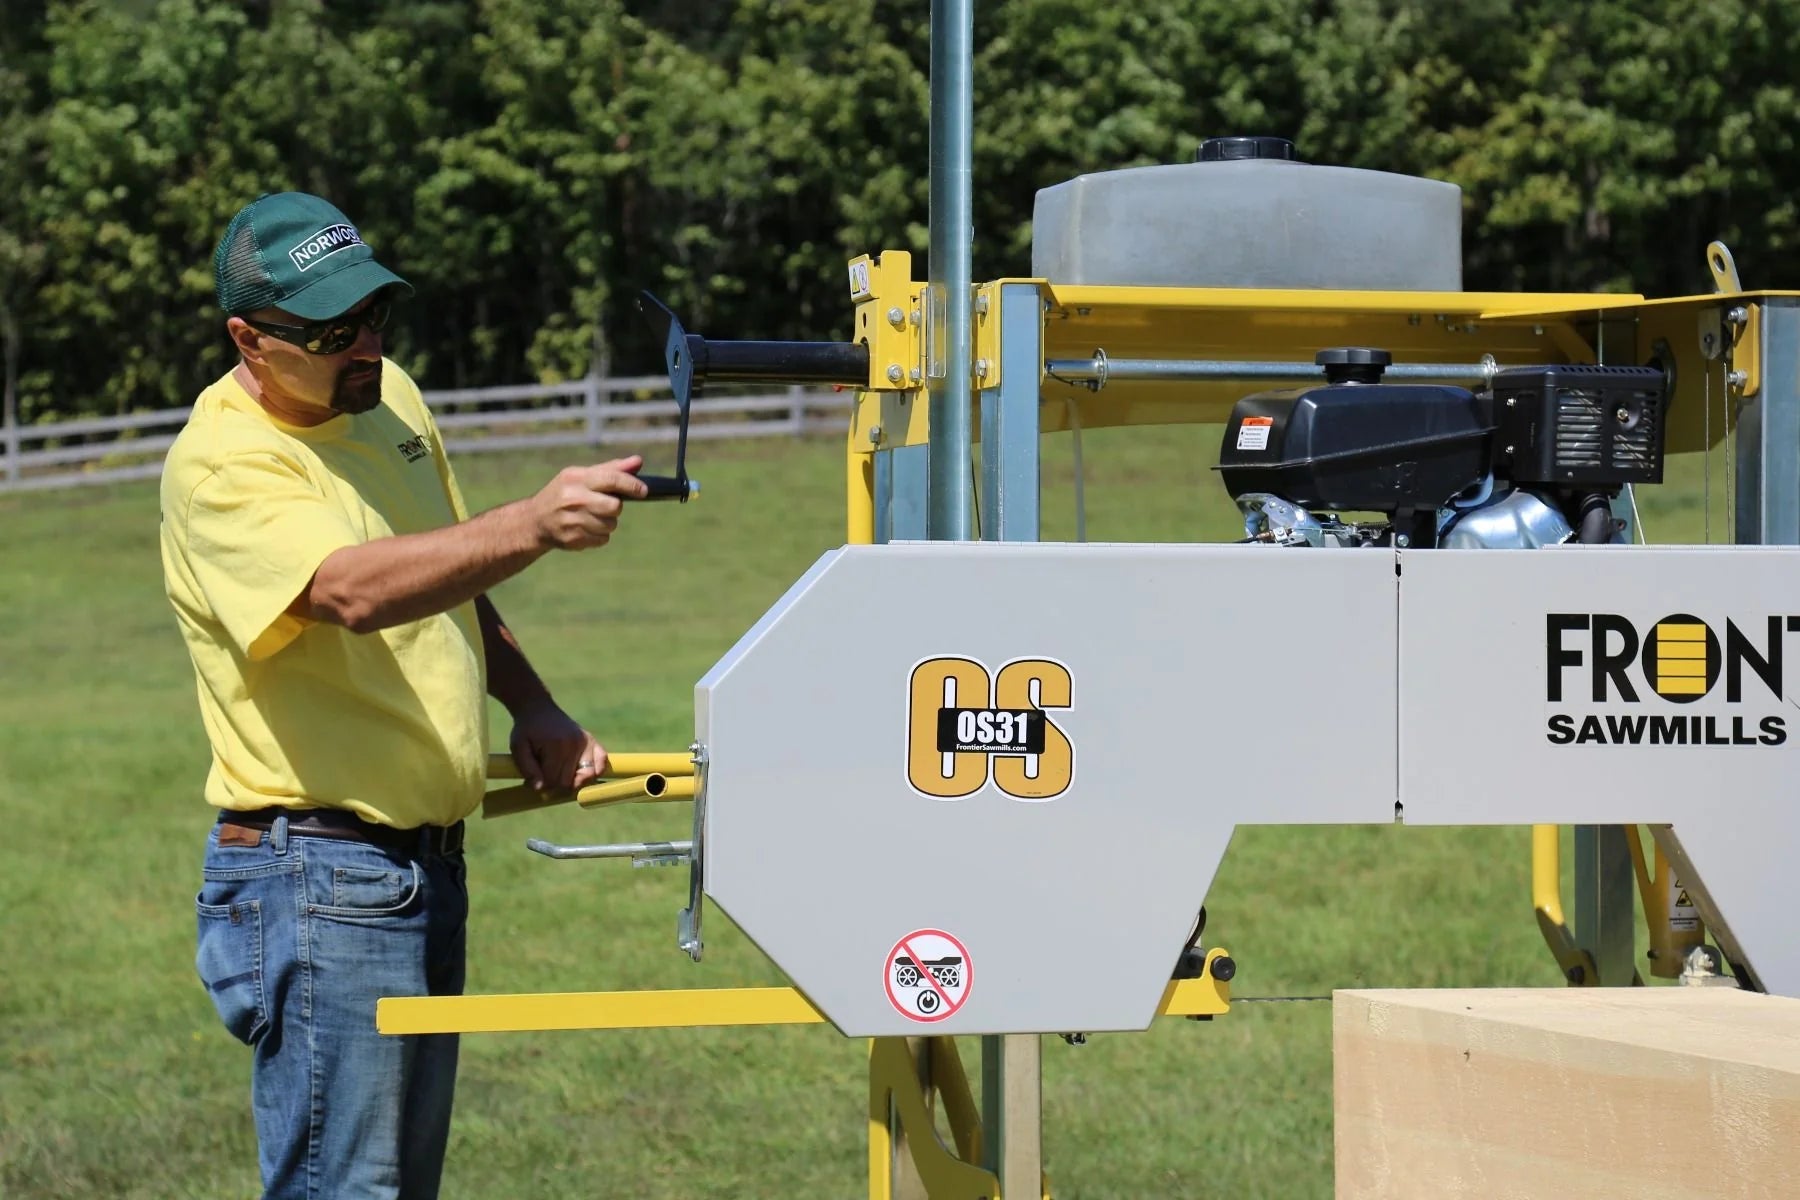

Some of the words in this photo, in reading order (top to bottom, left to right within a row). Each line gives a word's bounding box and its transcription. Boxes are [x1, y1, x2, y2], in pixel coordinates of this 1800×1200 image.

[1546, 613, 1800, 704] FRON
[957, 710, 1028, 744] OS31
[1546, 714, 1787, 746] SAWMILLS
[956, 743, 1028, 752] FrontierSawmills.com
